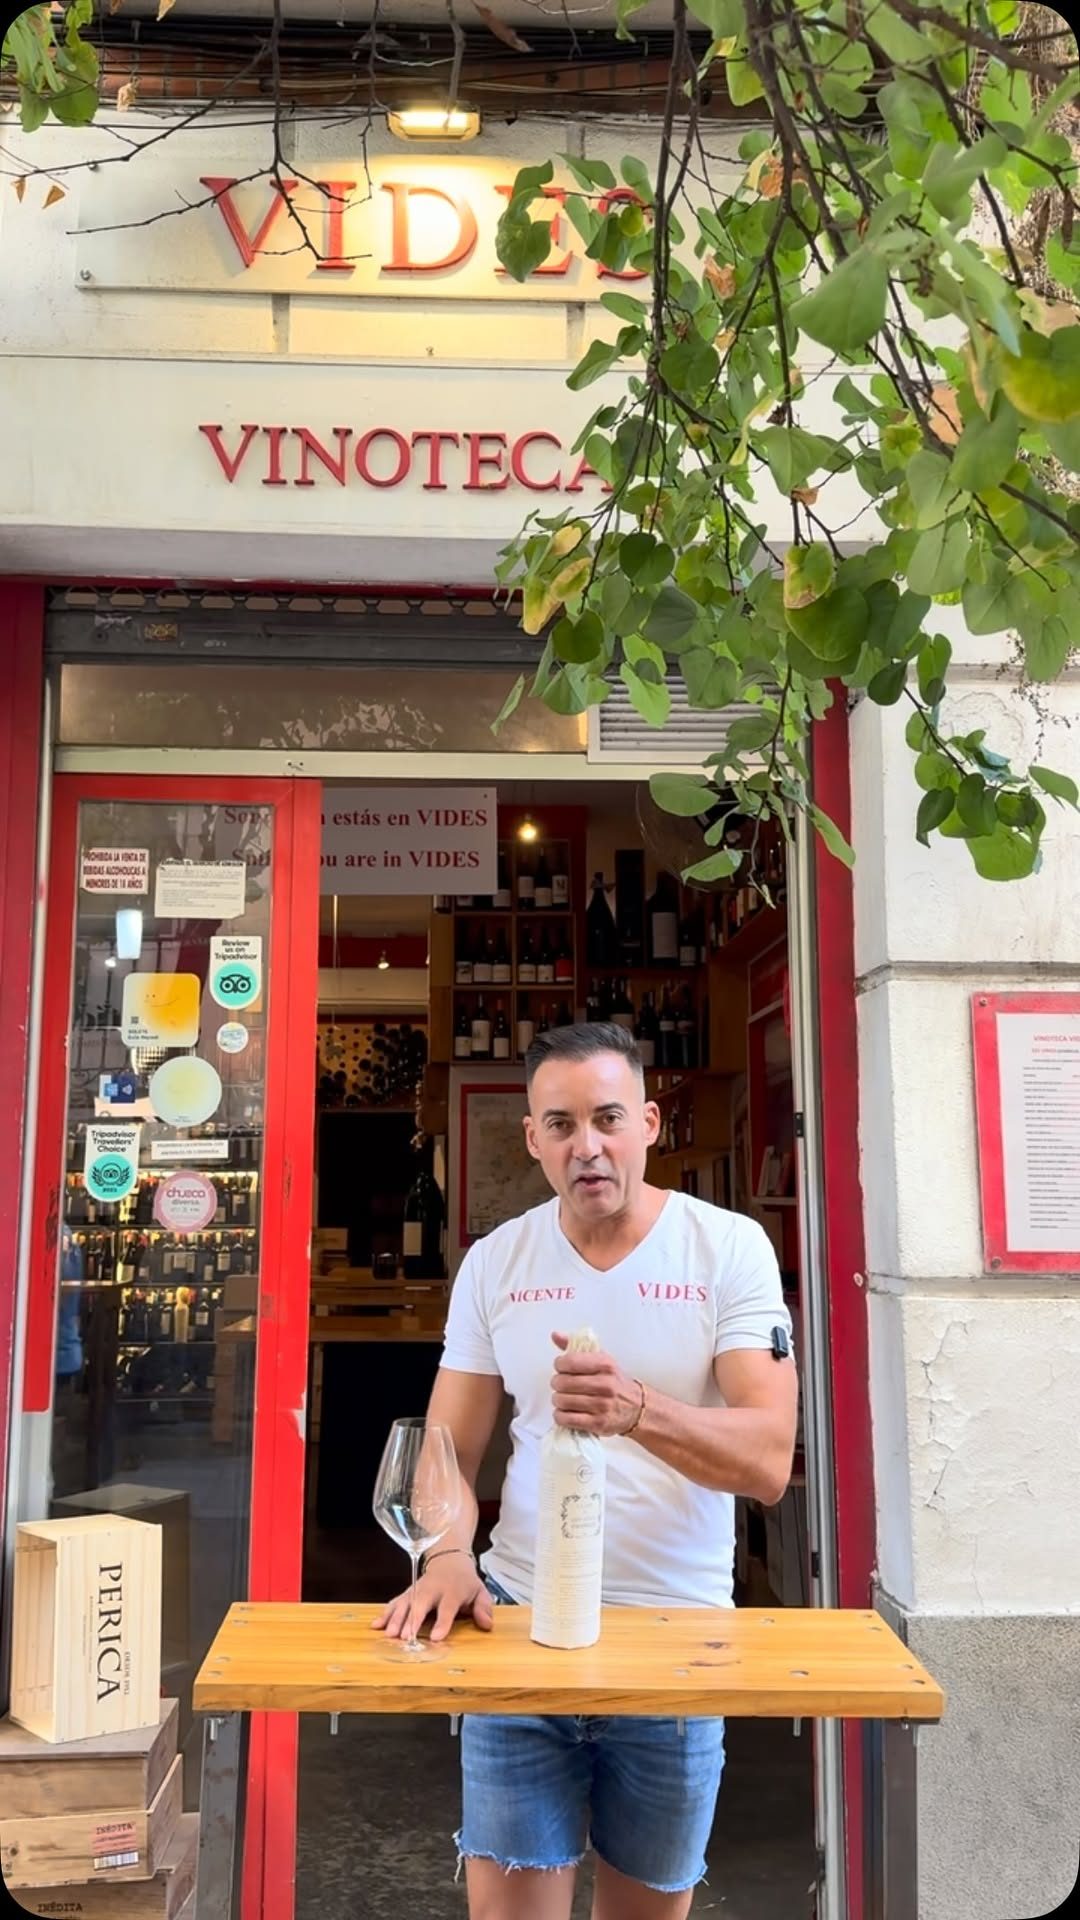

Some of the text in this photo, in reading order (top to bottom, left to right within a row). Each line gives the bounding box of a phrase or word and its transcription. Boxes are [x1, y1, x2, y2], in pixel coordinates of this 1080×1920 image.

[332, 807, 381, 827] estás
[387, 813, 410, 827] en
[416, 809, 488, 828] VIDES
[113, 852, 120, 862] LA
[121, 852, 138, 862] VENTA
[139, 852, 146, 862] DE
[345, 854, 376, 868] are
[383, 850, 401, 868] in
[408, 850, 480, 869] VIDES
[83, 865, 105, 875] BEBIDAS
[85, 878, 110, 889] MENORES
[111, 879, 118, 889] DE
[127, 876, 143, 889] AÑOS
[222, 939, 250, 947] Review
[214, 952, 257, 961] Tripadvisor
[91, 1130, 136, 1138] Tripadvisor
[97, 1145, 127, 1153] Choice
[637, 1282, 708, 1302] VIDES
[97, 1561, 123, 1704] PERICA
[37, 1901, 83, 1913] INÉDITA
